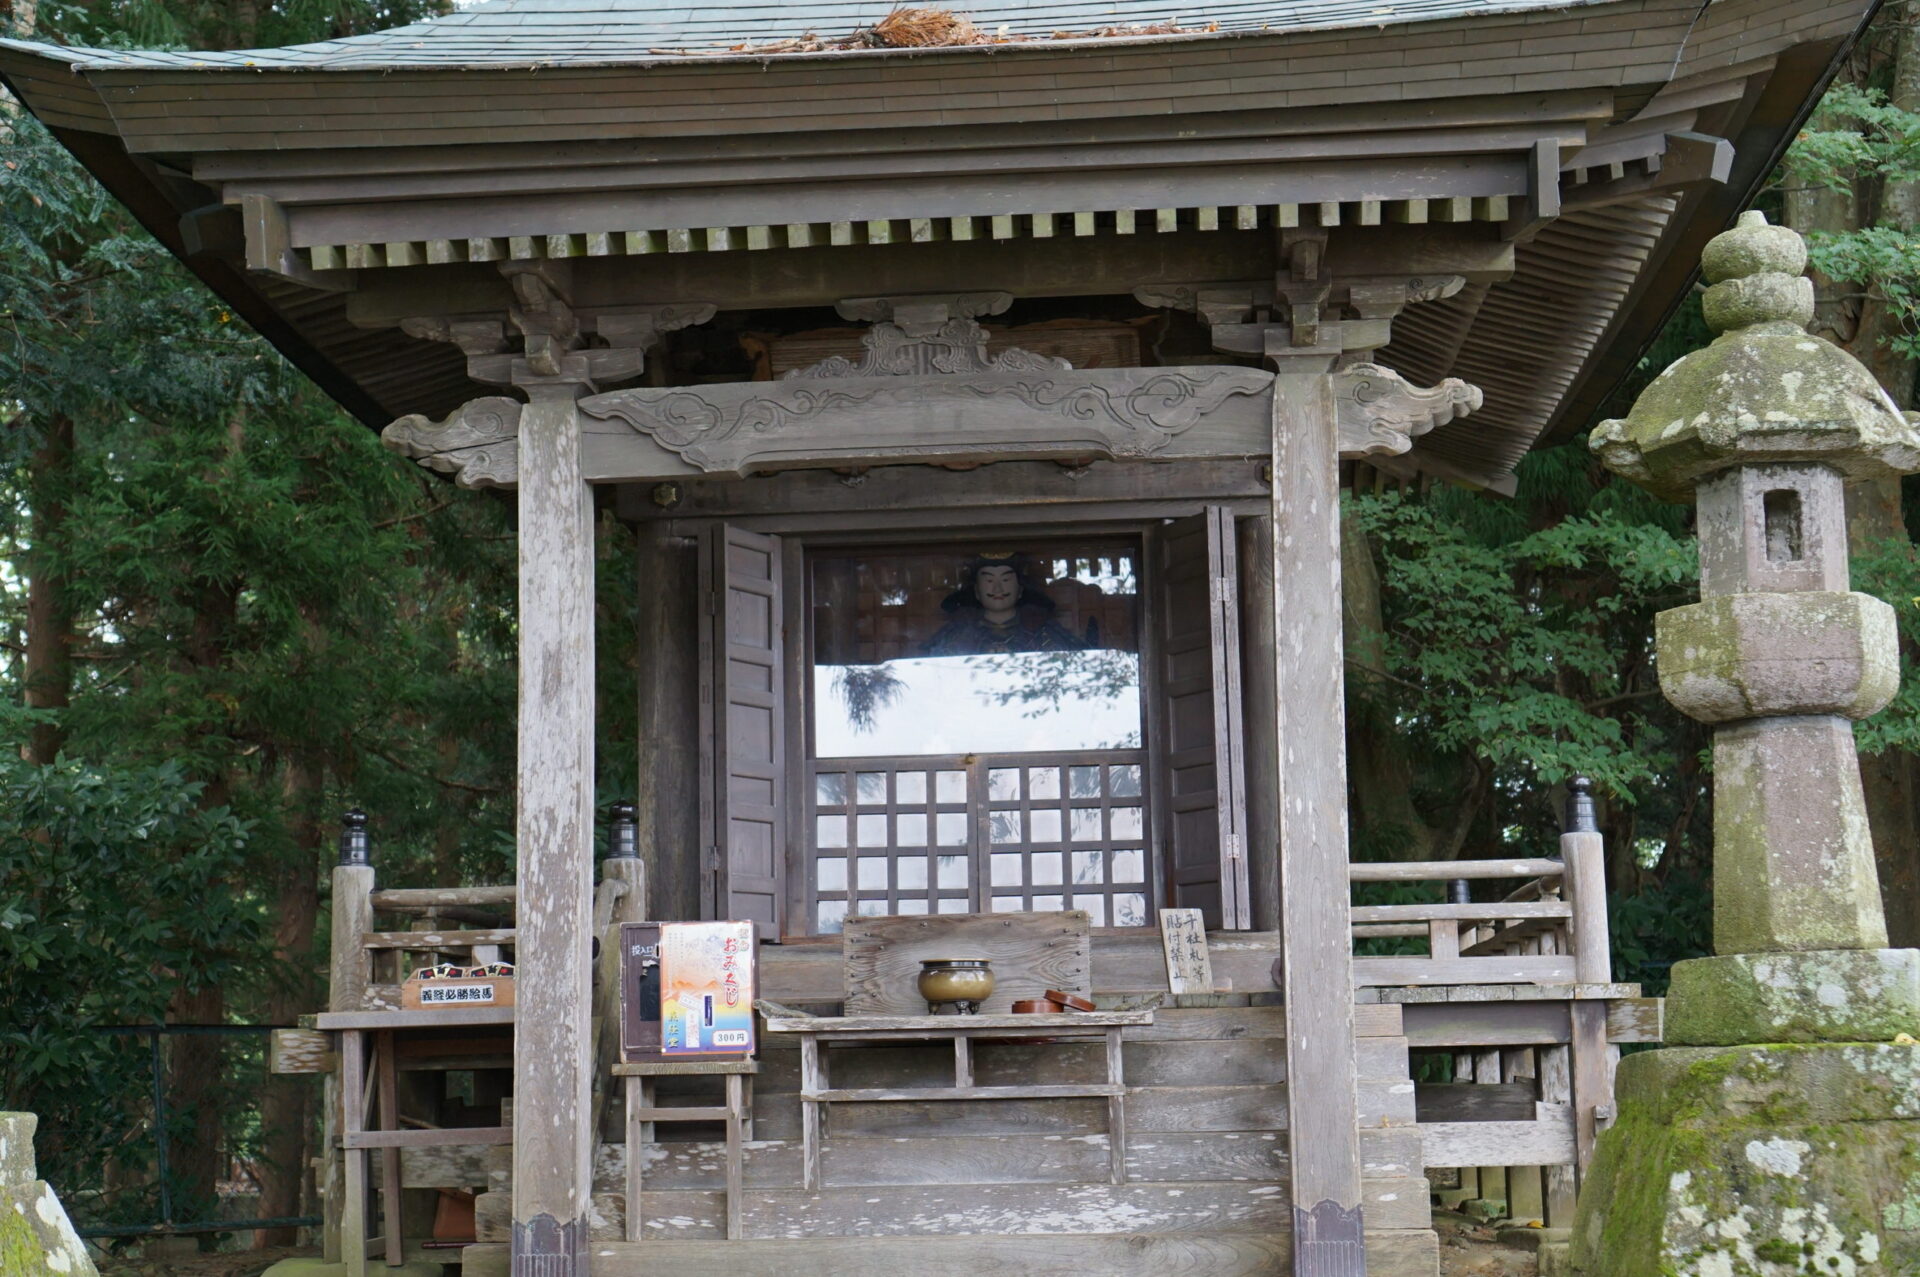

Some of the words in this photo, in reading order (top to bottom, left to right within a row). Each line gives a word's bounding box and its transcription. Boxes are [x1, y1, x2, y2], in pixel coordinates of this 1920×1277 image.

[1166, 914, 1188, 979] 貼付禁止
[723, 937, 740, 1008] おみくじ
[422, 987, 492, 1001] 義経必勝絵馬
[717, 1032, 745, 1043] 300円
